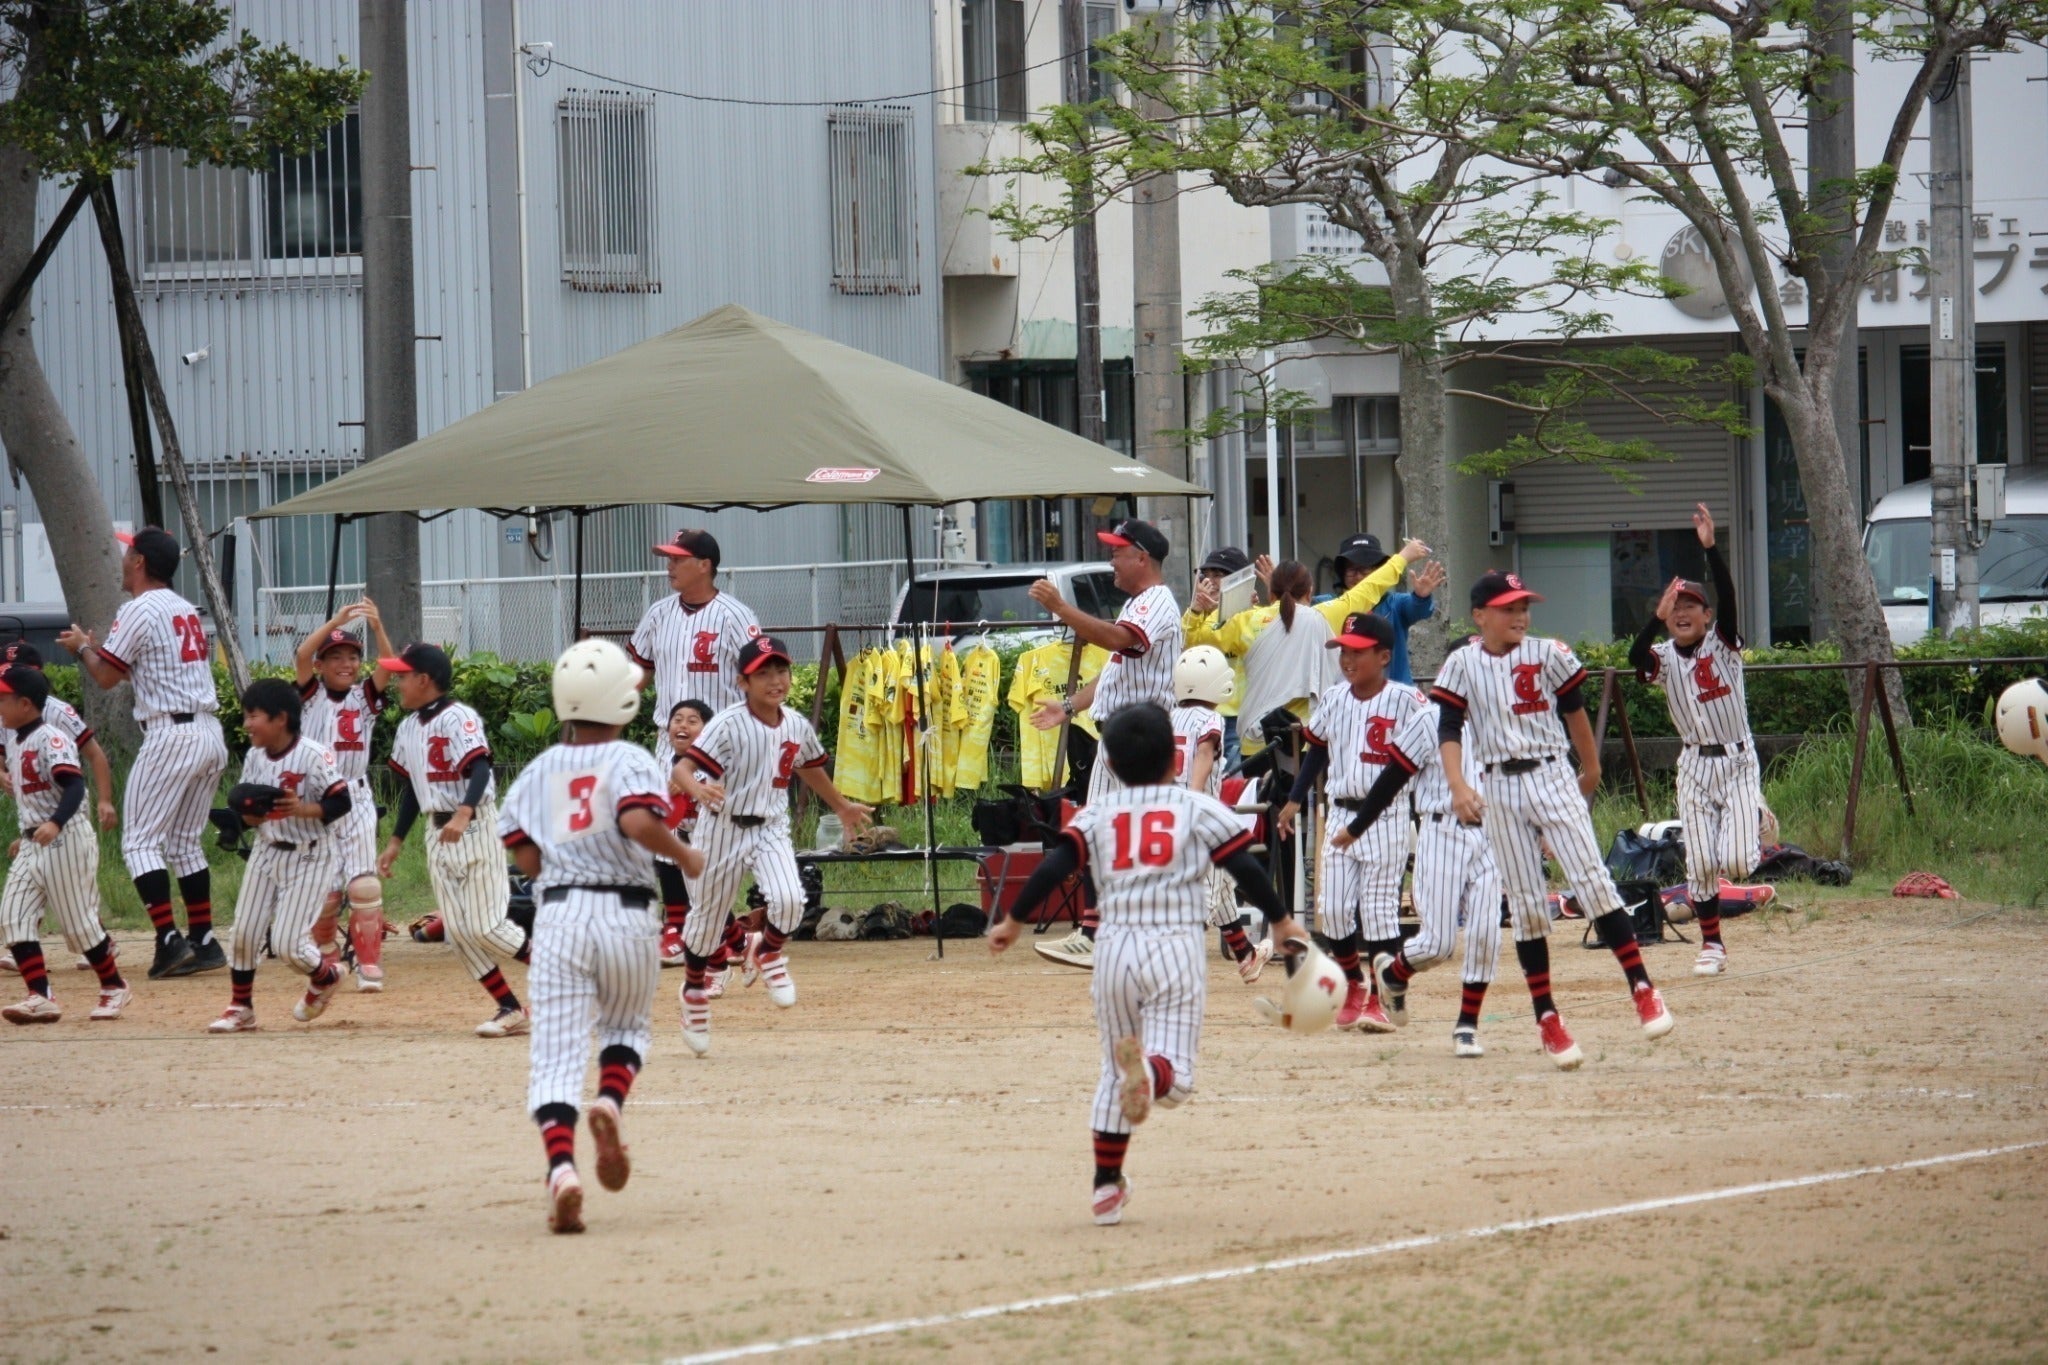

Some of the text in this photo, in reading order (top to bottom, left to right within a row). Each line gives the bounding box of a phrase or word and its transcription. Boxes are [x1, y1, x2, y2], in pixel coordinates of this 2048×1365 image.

[172, 614, 208, 663] 28
[568, 775, 597, 833] 3
[1112, 810, 1175, 871] 16
